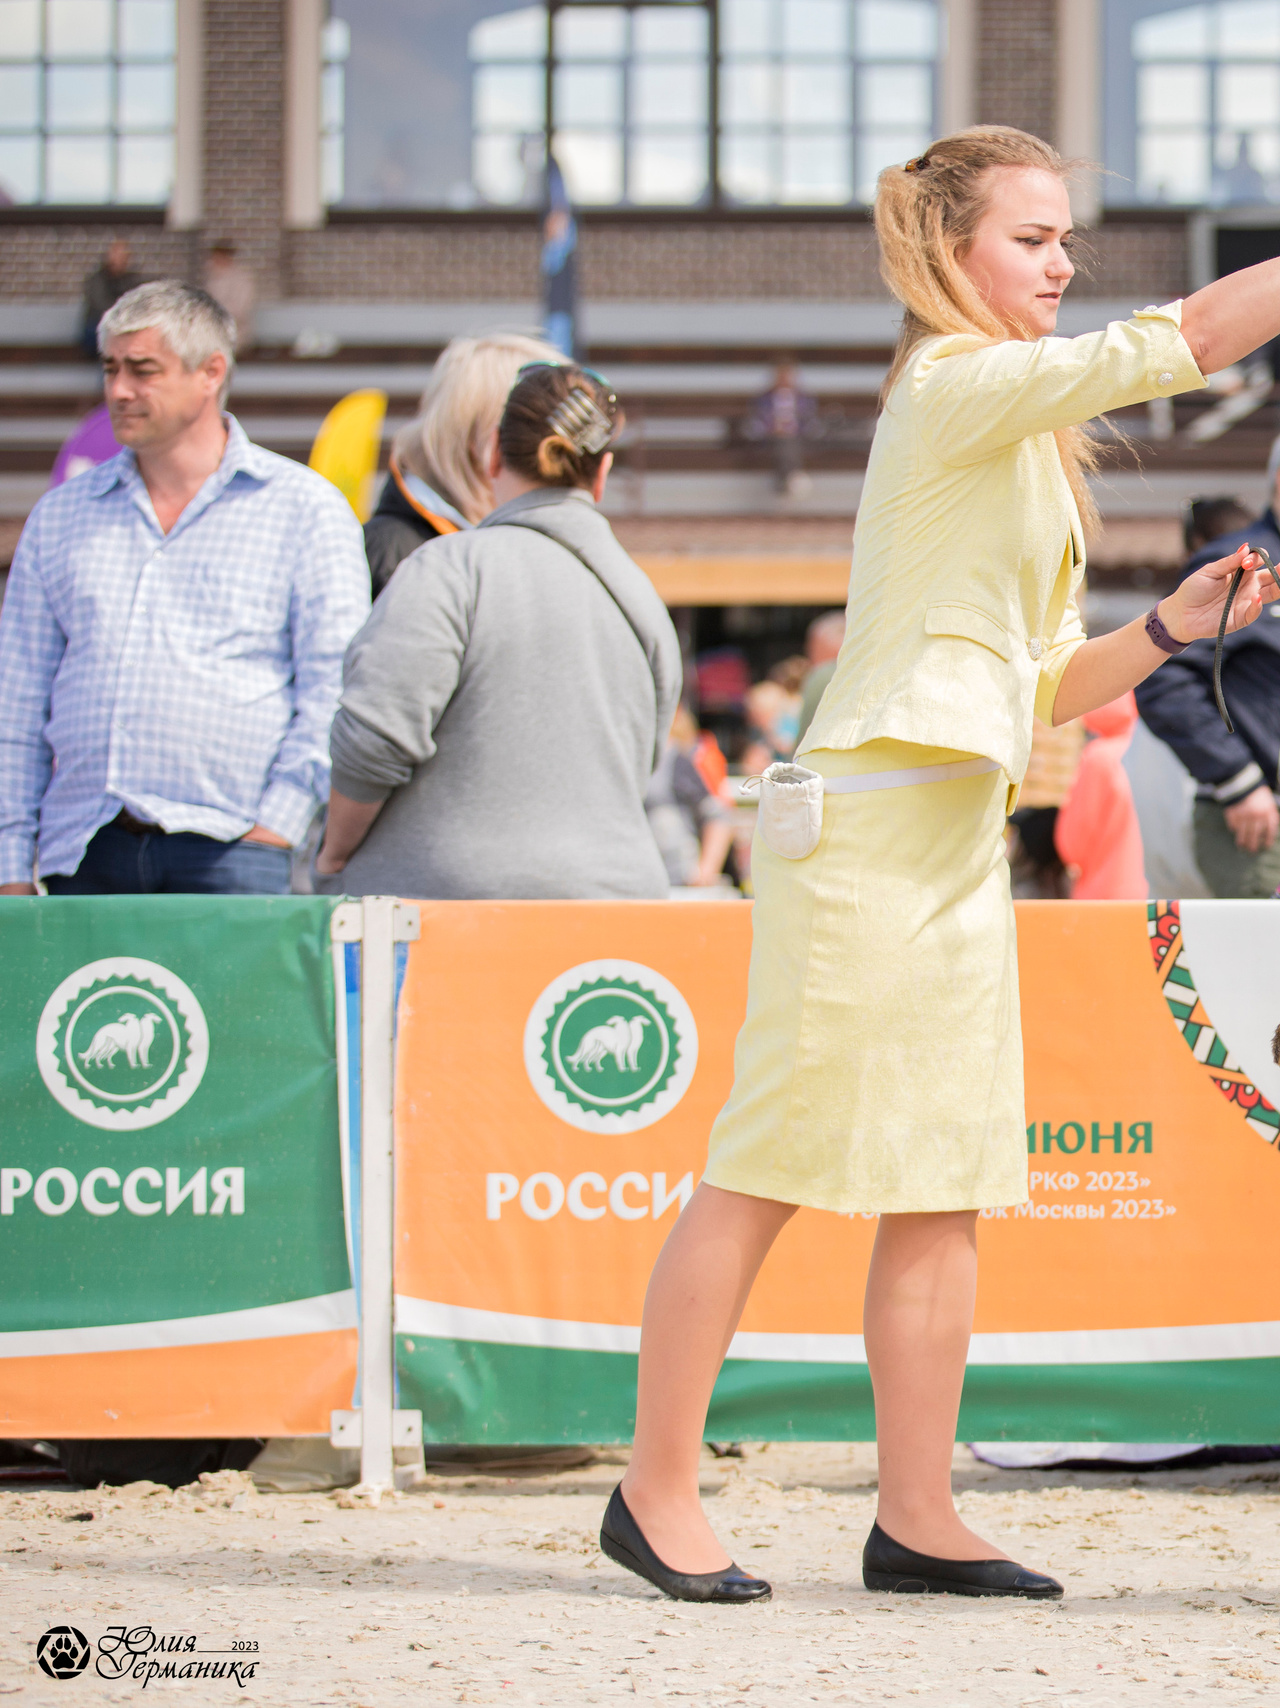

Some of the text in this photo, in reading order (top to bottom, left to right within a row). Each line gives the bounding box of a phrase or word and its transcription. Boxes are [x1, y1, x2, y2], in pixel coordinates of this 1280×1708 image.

[0, 1166, 245, 1216] РОССИЯ
[486, 1171, 694, 1221] РОССИ
[1030, 1171, 1151, 1191] РКФ 2023»
[1014, 1200, 1105, 1219] Москвы
[1111, 1200, 1176, 1219] 2023»
